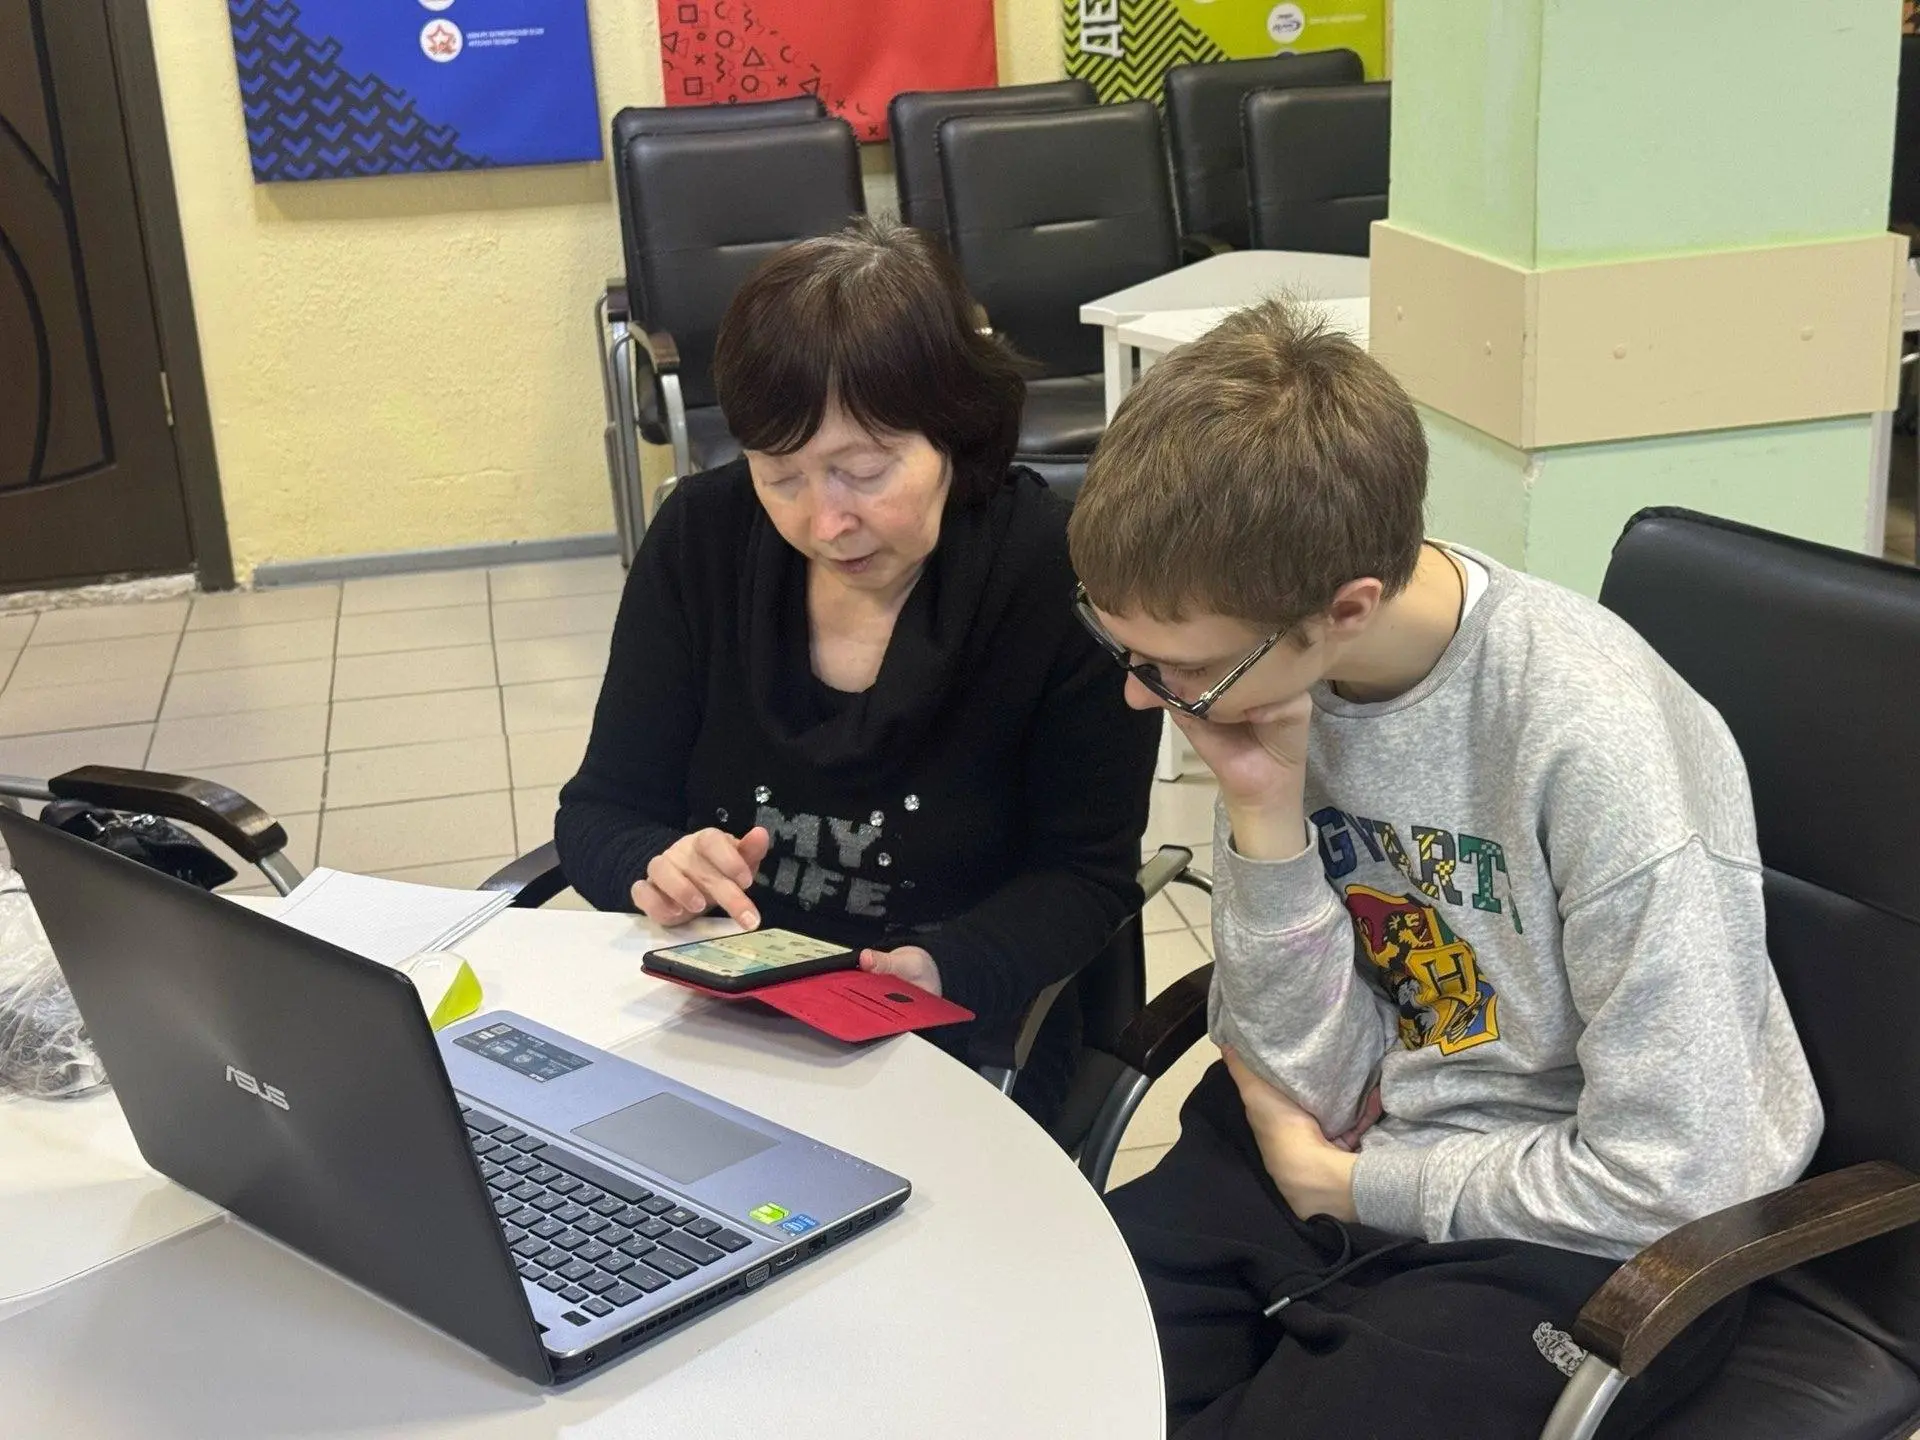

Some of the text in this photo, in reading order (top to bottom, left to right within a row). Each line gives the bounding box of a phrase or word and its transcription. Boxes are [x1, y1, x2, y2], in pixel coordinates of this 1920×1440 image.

[755, 805, 883, 868] MY
[755, 857, 892, 917] IFE
[1422, 952, 1468, 998] H
[225, 1064, 290, 1111] ASUS
